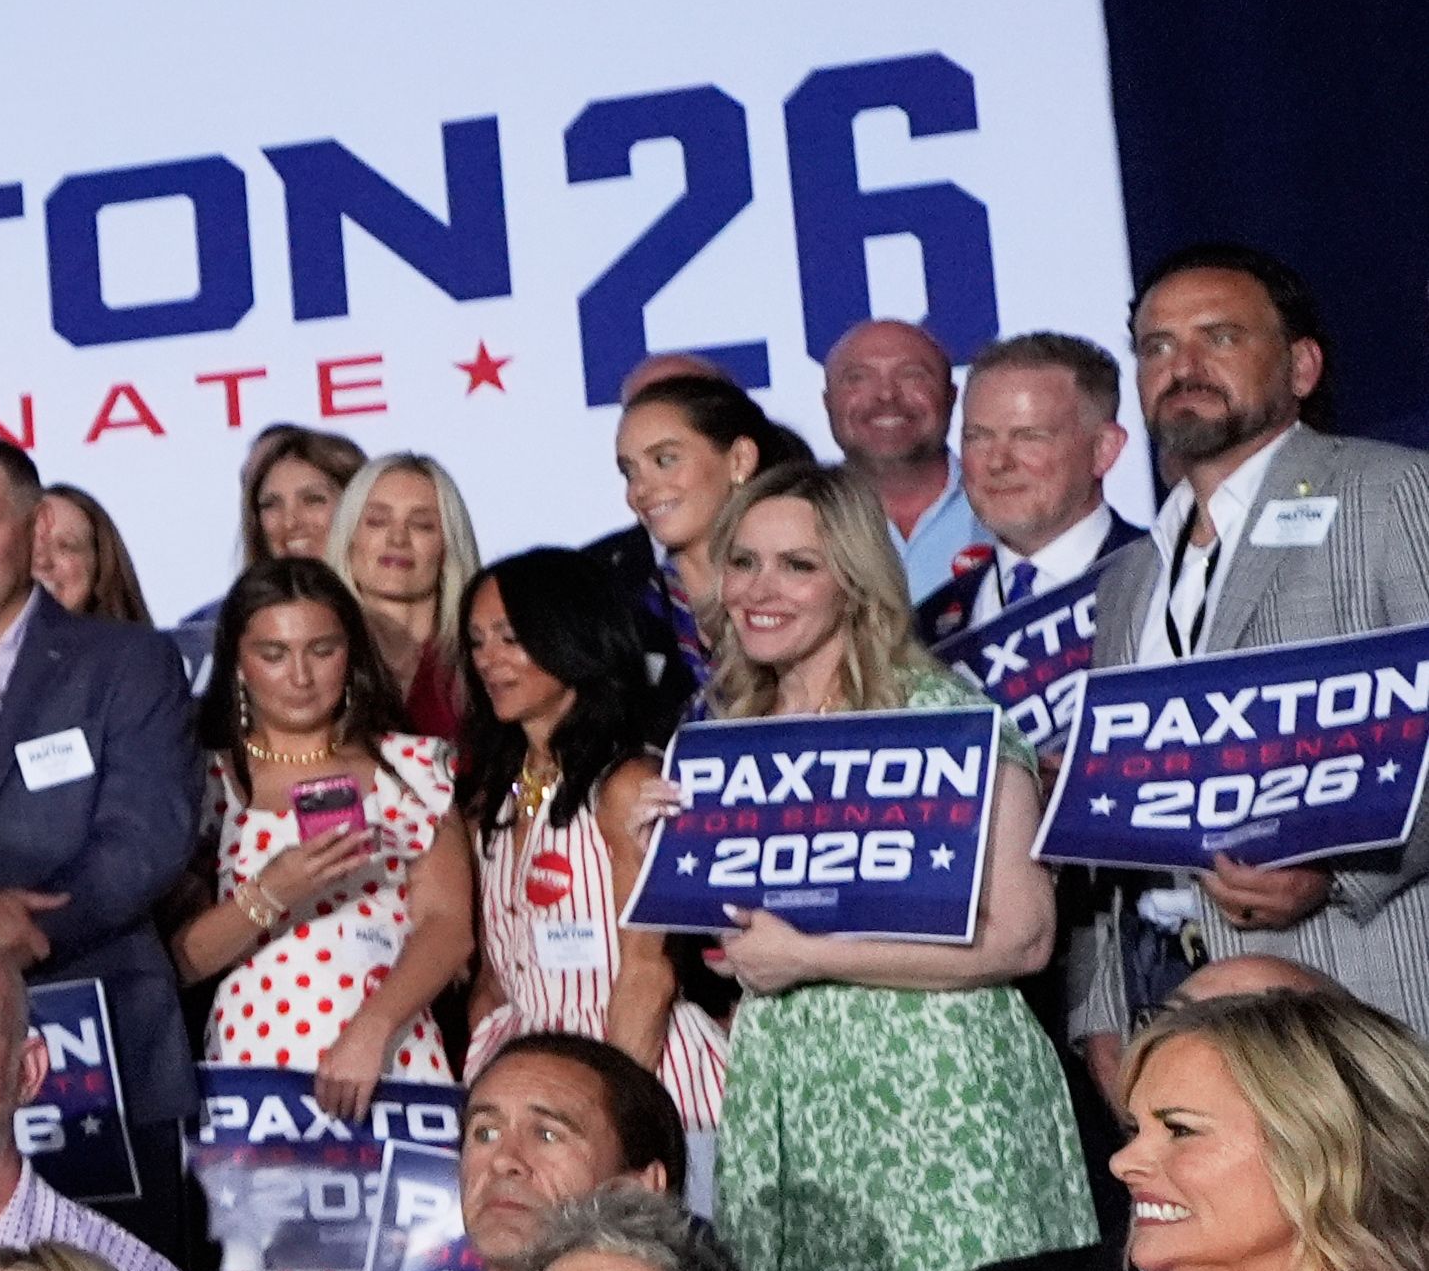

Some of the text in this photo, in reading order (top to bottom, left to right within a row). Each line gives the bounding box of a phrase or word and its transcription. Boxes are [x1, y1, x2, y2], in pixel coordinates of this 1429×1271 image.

[563, 49, 1001, 408] 26
[1090, 660, 1429, 754] PAXTON
[677, 745, 983, 810] PAXTON
[1130, 753, 1364, 831] 2026
[783, 801, 974, 828] SENATE
[707, 829, 916, 887] 2026
[199, 1094, 461, 1143] PAXTO
